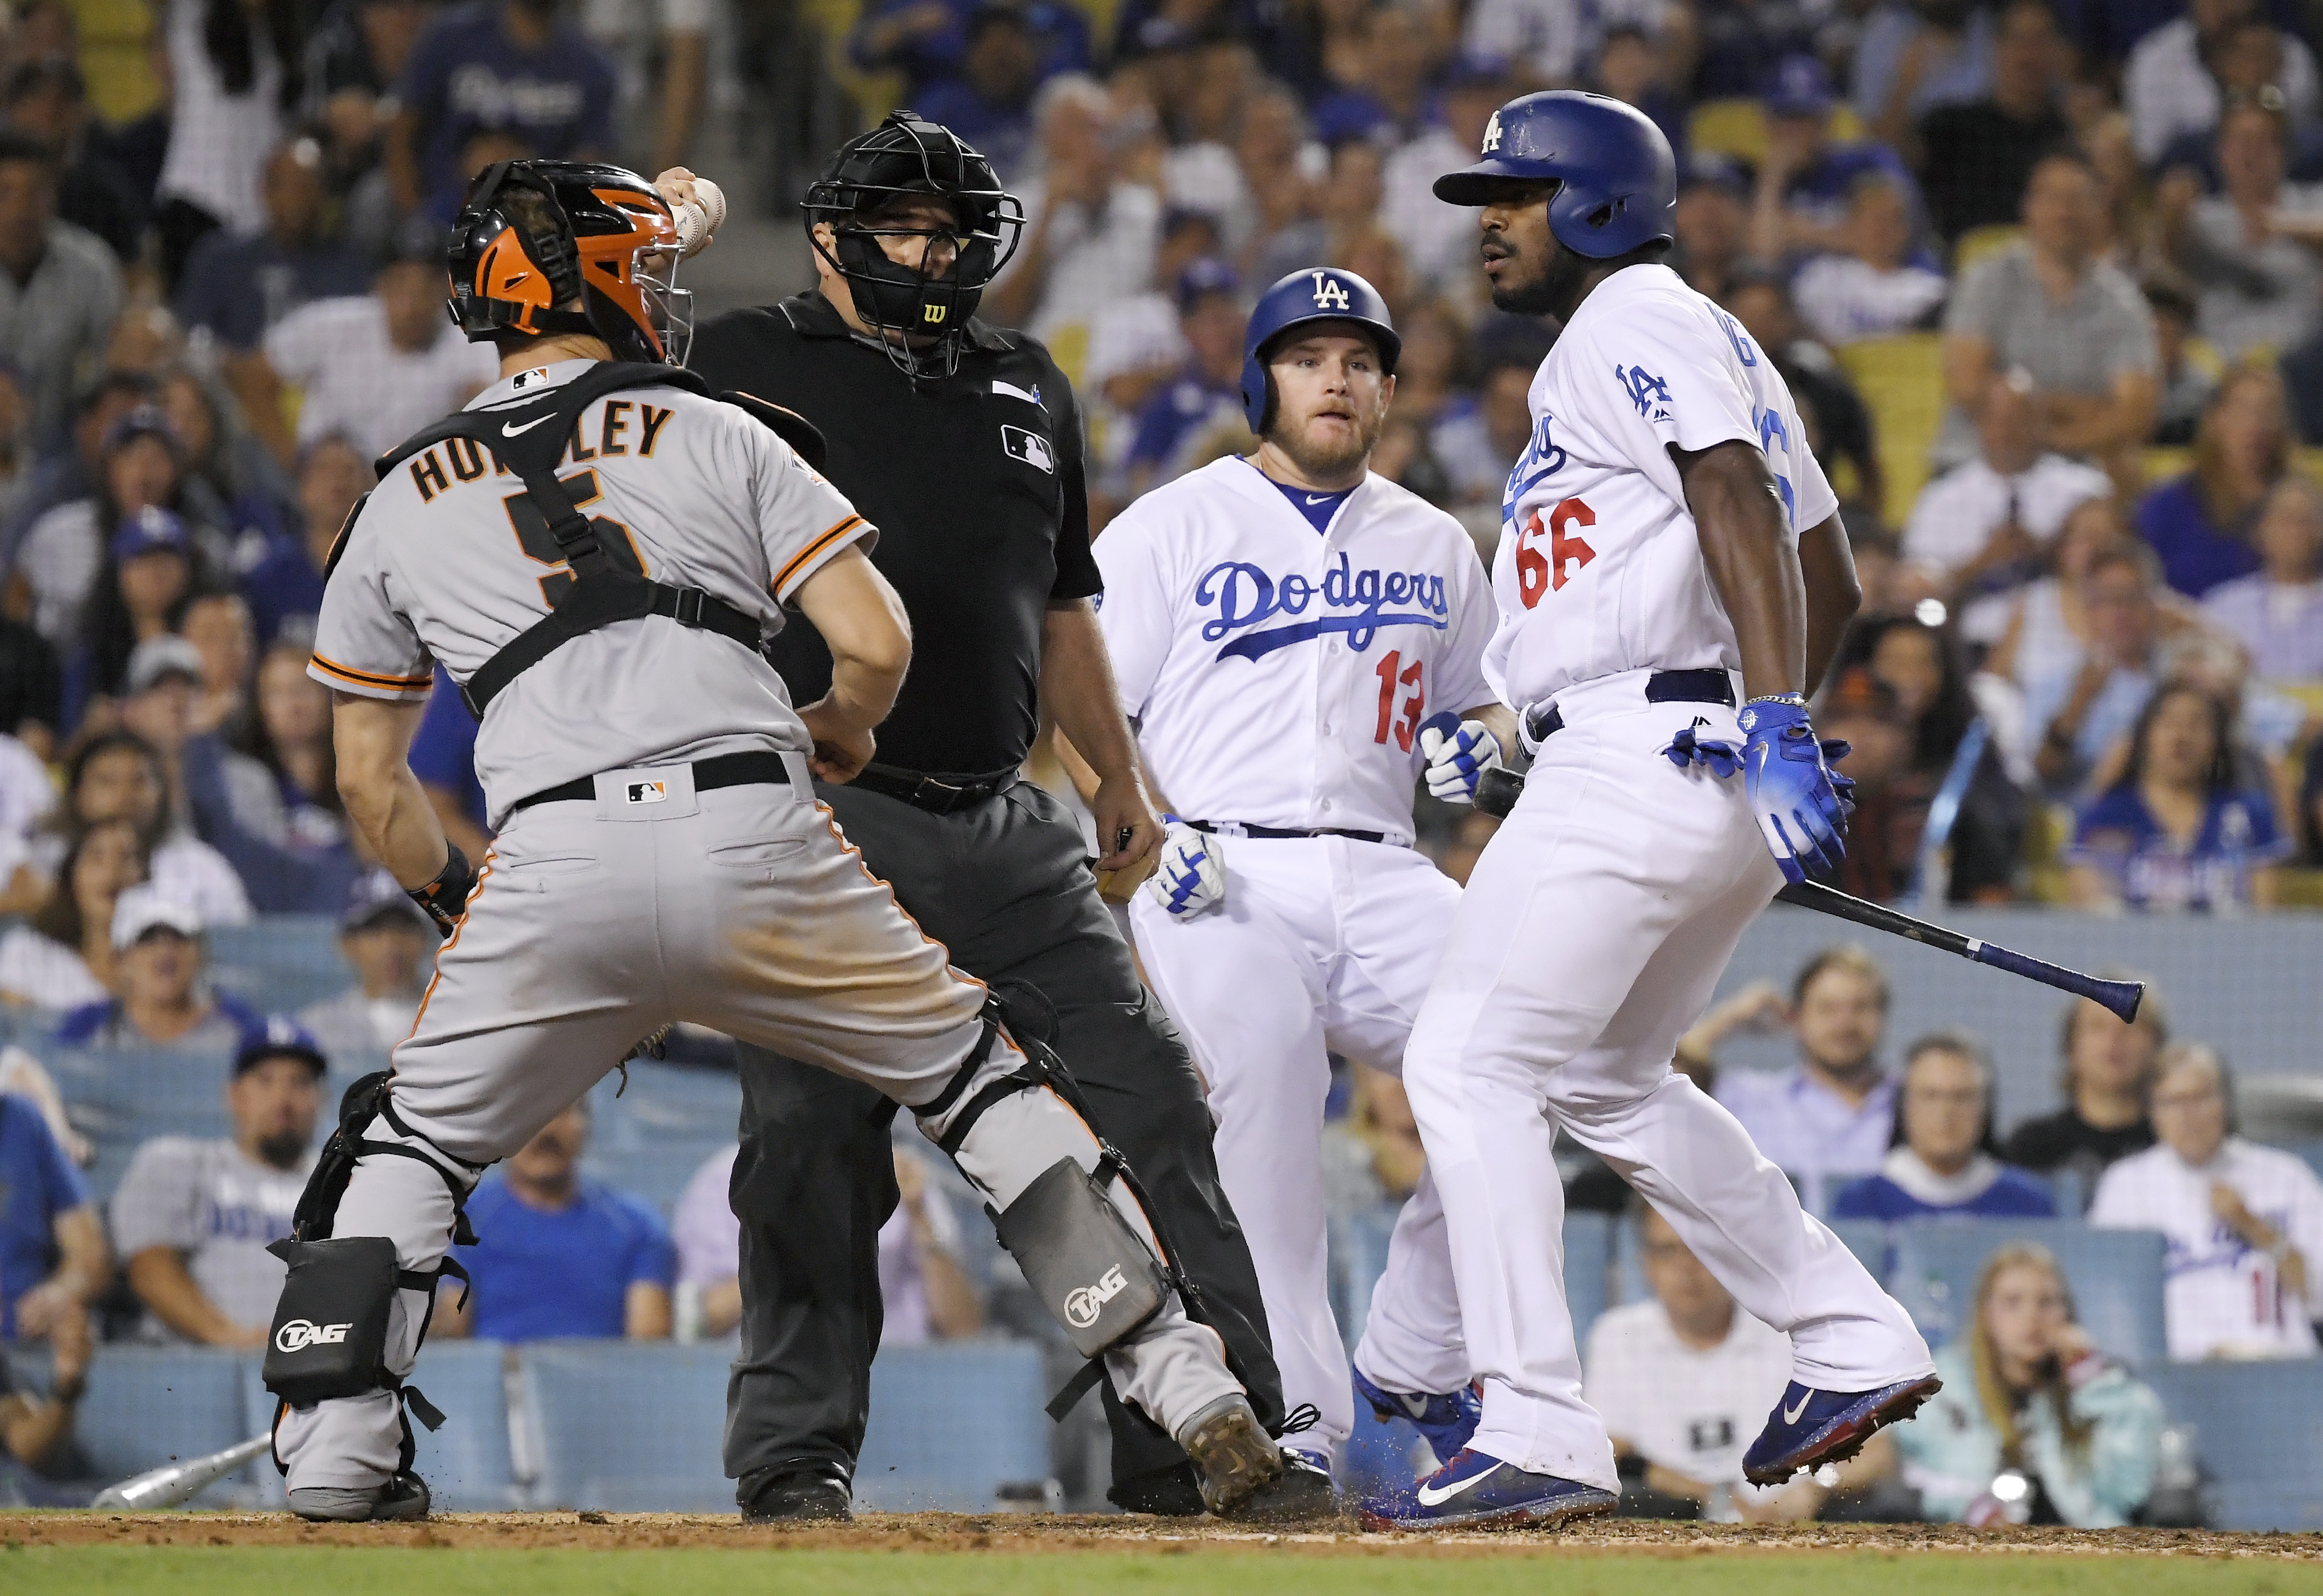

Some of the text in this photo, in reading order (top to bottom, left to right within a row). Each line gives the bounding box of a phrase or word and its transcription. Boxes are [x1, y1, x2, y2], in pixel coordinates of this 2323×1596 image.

[1312, 272, 1350, 310] LA
[1615, 364, 1673, 418] LA
[409, 399, 675, 504] HULEY
[1195, 552, 1448, 652] Dodgers
[1516, 497, 1597, 610] 66
[1374, 650, 1425, 754] 13
